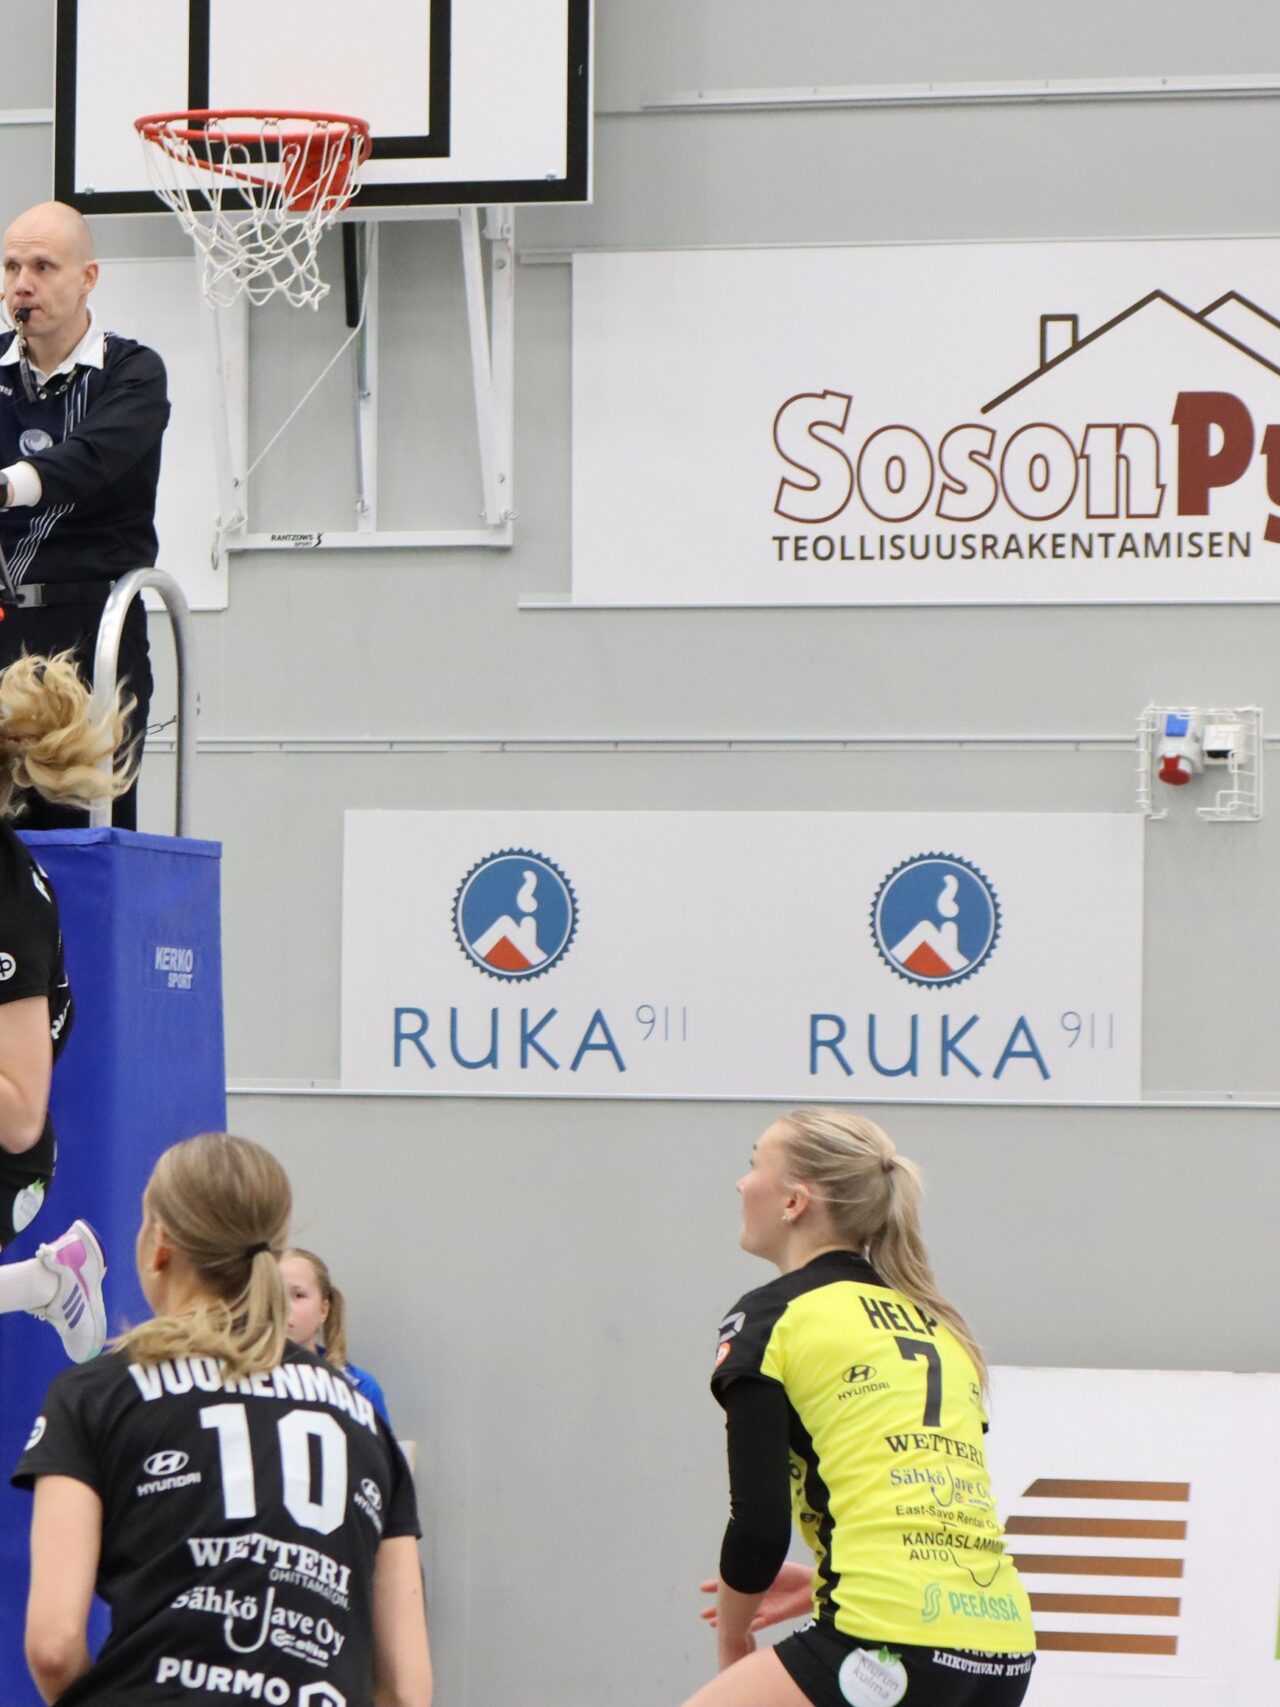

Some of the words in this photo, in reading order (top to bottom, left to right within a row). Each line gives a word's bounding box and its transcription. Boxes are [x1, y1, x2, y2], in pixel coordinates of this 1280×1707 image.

[772, 531, 1252, 562] TEOLLISUUSRAKENTAMISEN
[154, 946, 194, 972] KERKO
[393, 1006, 627, 1073] RUKA
[635, 1004, 688, 1042] 911
[809, 1013, 1052, 1081] RUKA
[1061, 1011, 1115, 1050] 911
[837, 1381, 891, 1401] HYUNDAI
[893, 1335, 942, 1428] 7
[884, 1433, 985, 1469] WETTERI
[136, 1471, 202, 1498] HYUNDAI
[199, 1402, 348, 1536] 10
[889, 1467, 946, 1487] Sähkö
[894, 1504, 956, 1521] East-Savo
[957, 1510, 985, 1529] Rental
[186, 1531, 352, 1595] WETTERI
[908, 1548, 950, 1562] AUTO
[947, 1590, 1022, 1622] PEEÄSSÄ
[315, 1617, 346, 1656] Oy
[155, 1656, 291, 1706] PURMO
